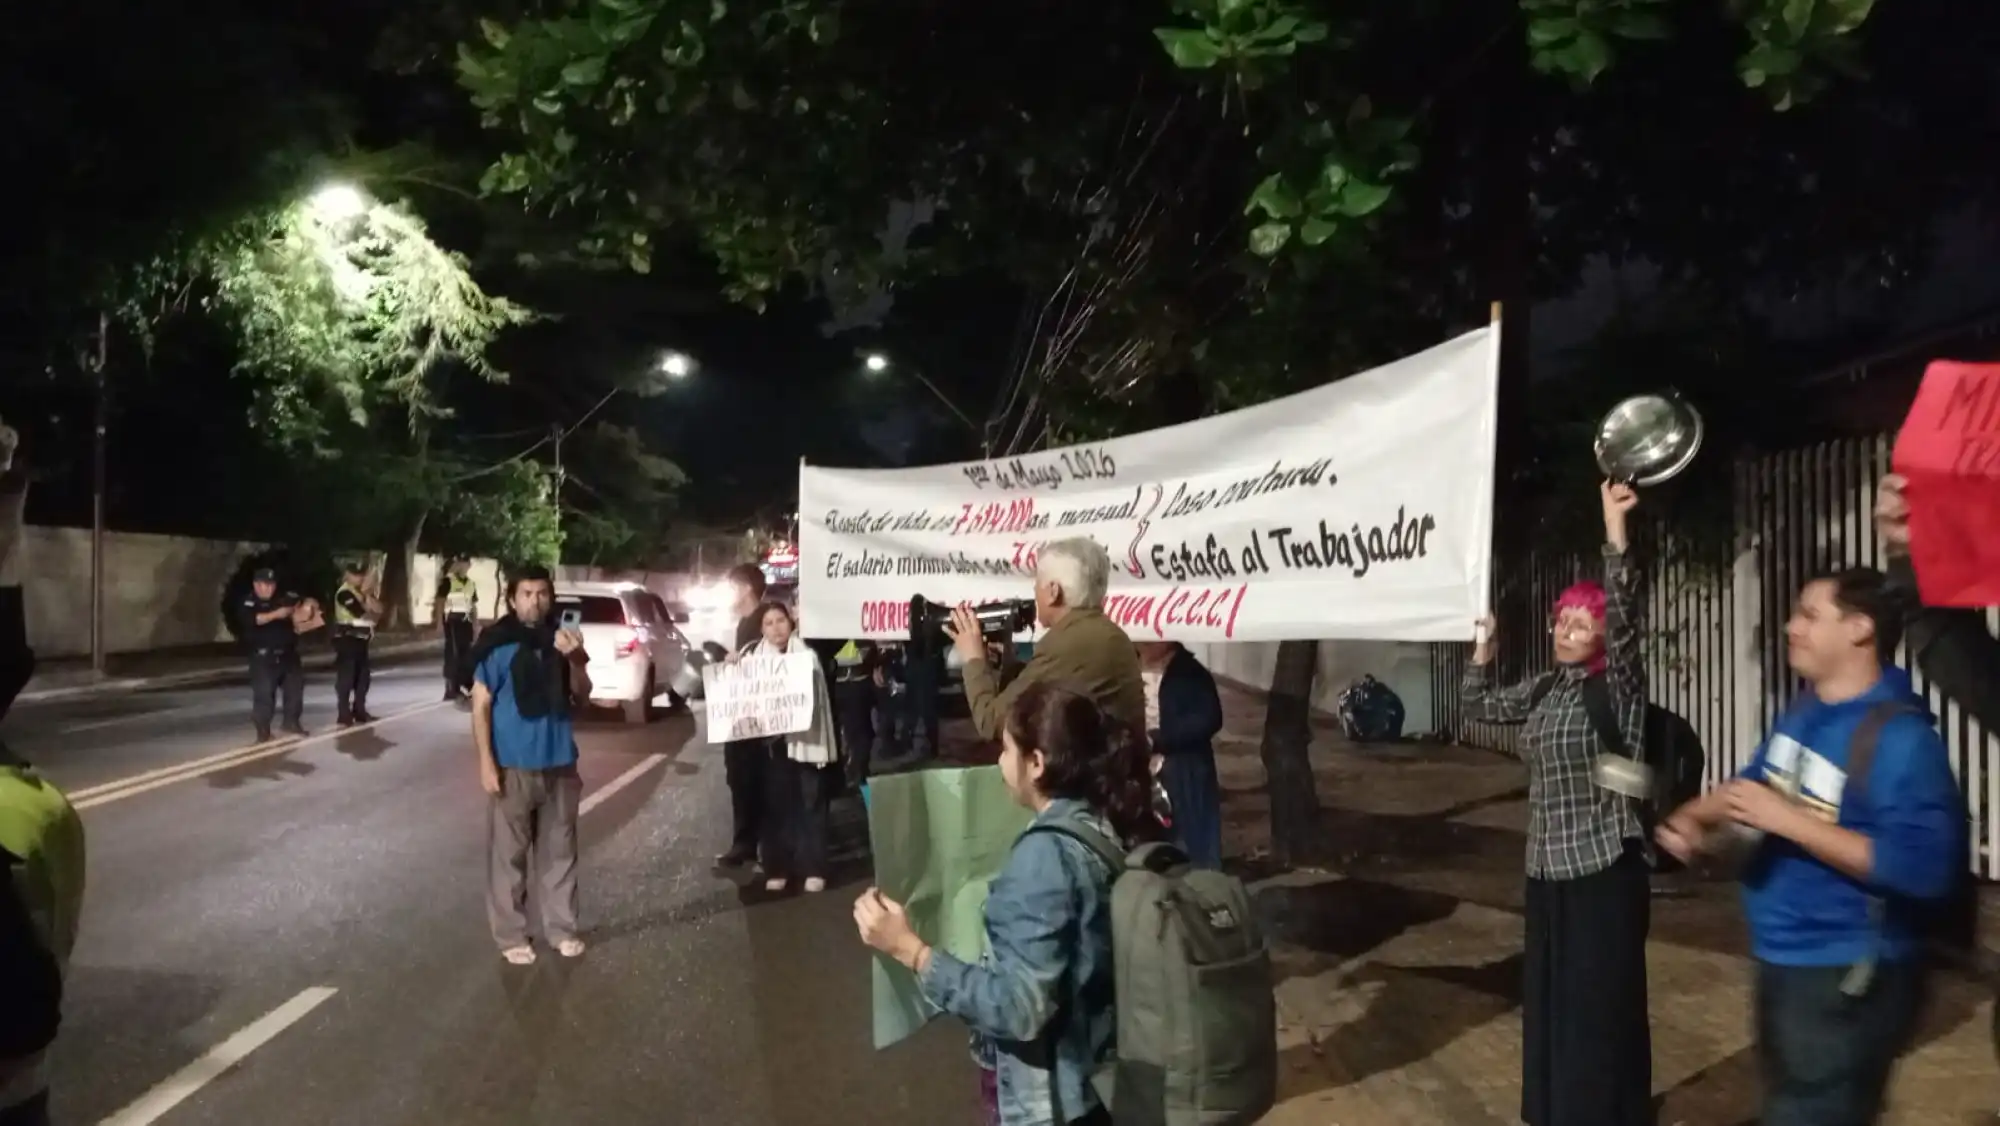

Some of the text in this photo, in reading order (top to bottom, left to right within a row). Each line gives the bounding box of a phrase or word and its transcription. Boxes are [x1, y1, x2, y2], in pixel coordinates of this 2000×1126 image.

[1934, 374, 2000, 432] MI
[1010, 458, 1062, 490] Mayo
[1061, 446, 1116, 480] 2026
[826, 551, 841, 578] El
[842, 549, 892, 578] salario
[1151, 507, 1436, 581] Estafa al Trabajador
